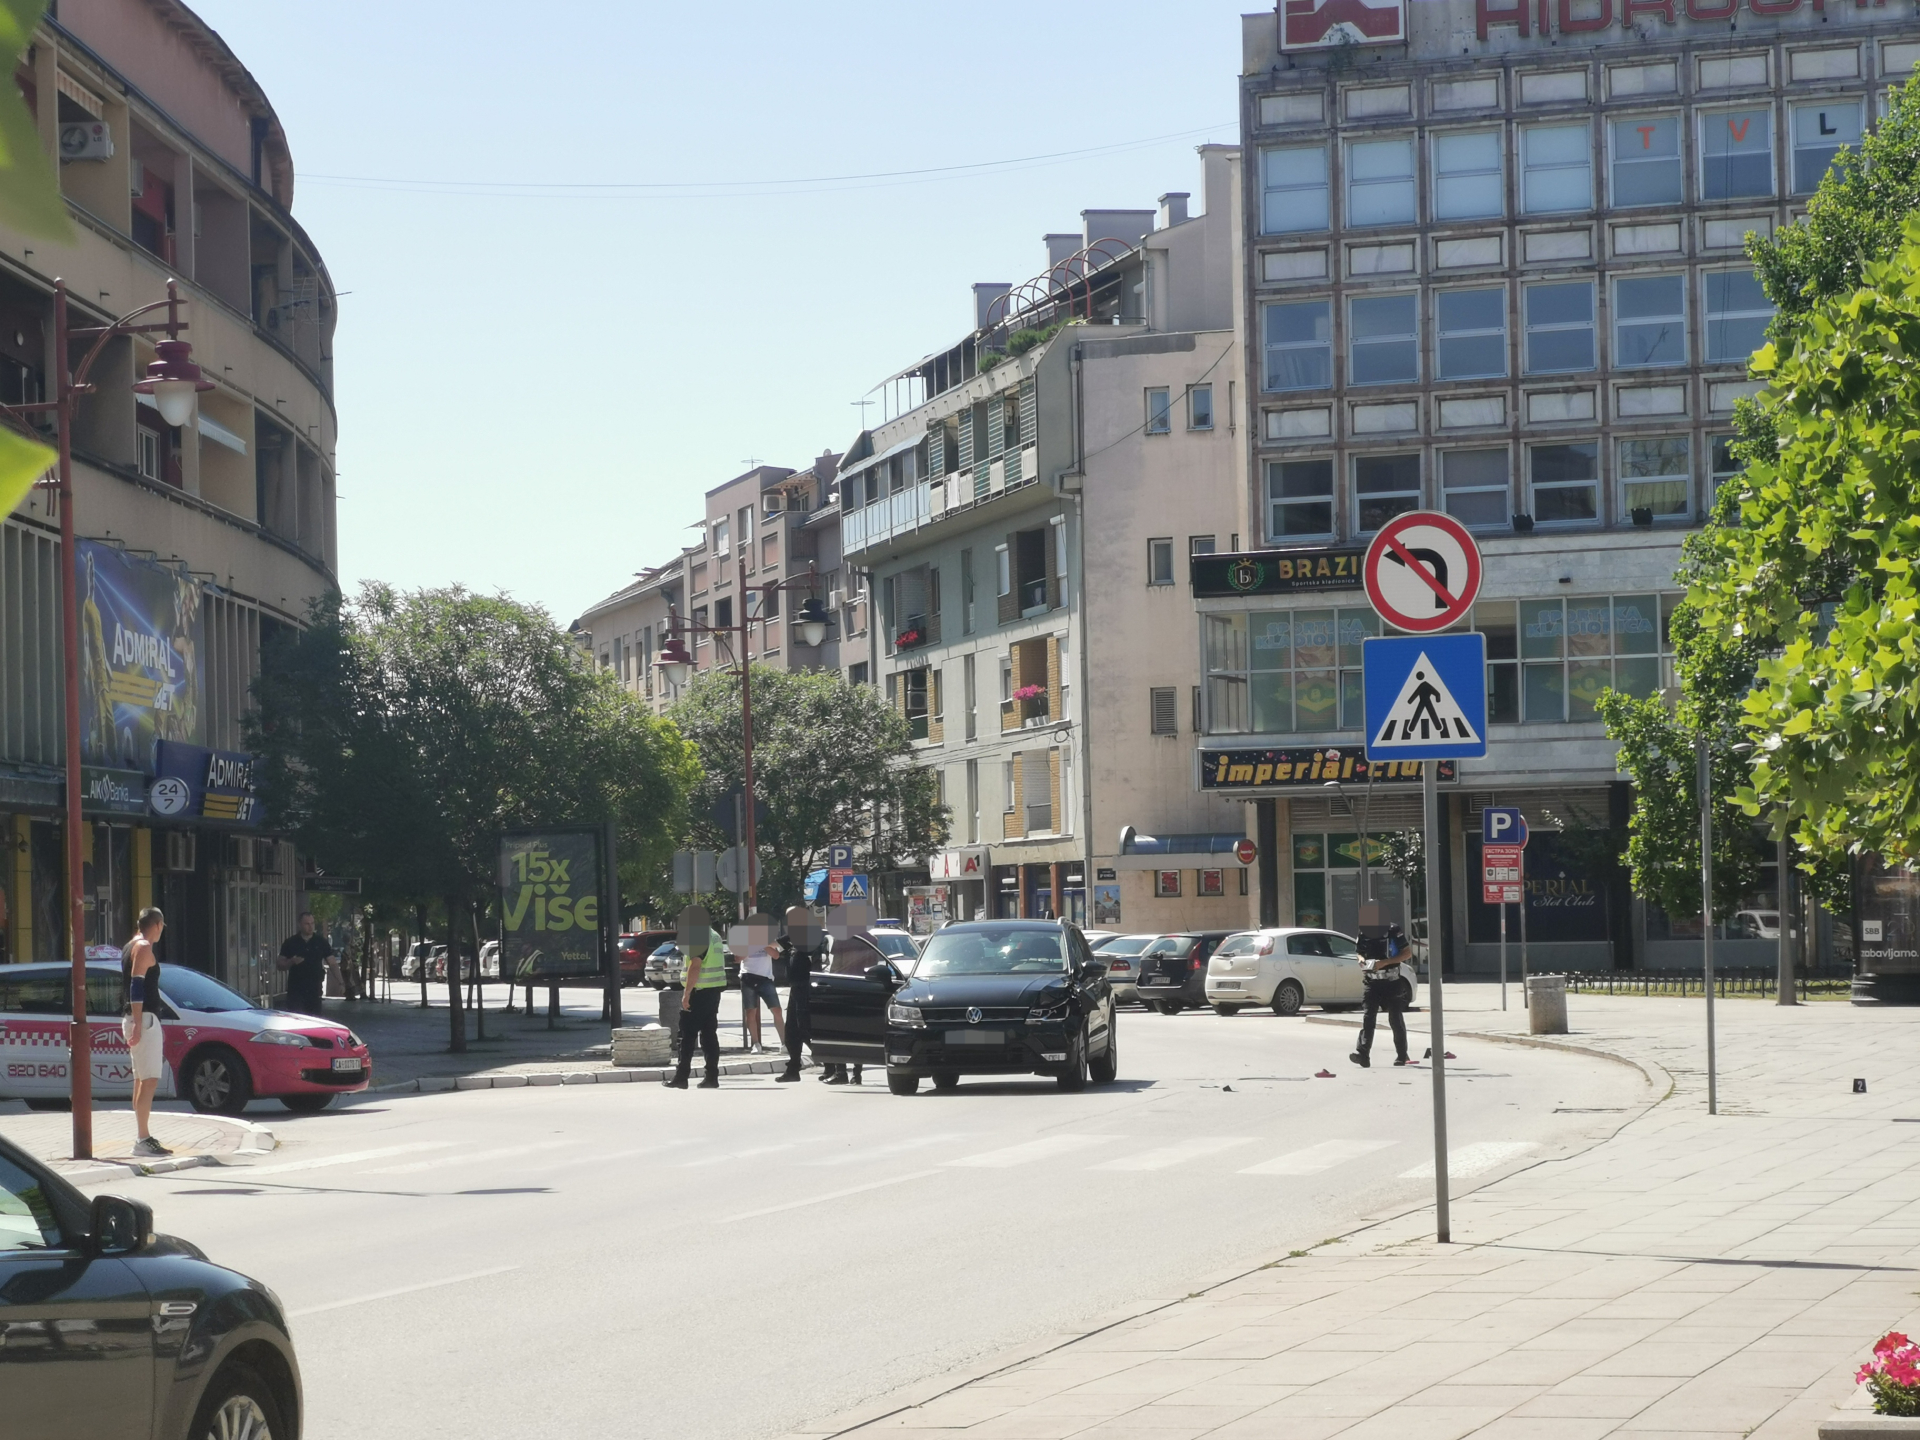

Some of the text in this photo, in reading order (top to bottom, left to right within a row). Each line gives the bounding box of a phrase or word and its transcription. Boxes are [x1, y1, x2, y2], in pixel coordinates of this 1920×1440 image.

[1279, 556, 1364, 580] BRAZI
[1538, 606, 1642, 624] SPORTSKA
[1266, 618, 1366, 637] SPORTSKA
[1526, 618, 1654, 638] KLADIONICA
[113, 622, 176, 678] ADMIRAL
[154, 682, 176, 712] BET
[1216, 754, 1355, 785] imperial
[90, 779, 129, 802] AIK Banka
[158, 783, 178, 796] 24
[164, 798, 174, 810] 7
[1491, 812, 1512, 839] P
[511, 851, 570, 882] 15x
[834, 849, 848, 866] P
[964, 854, 981, 873] A1
[1524, 879, 1594, 897] PERIAL
[503, 883, 598, 931] Više
[1864, 927, 1880, 935] SBB
[95, 1030, 127, 1045] PIN
[95, 1064, 133, 1079] TAX
[1857, 1080, 1864, 1091] 2
